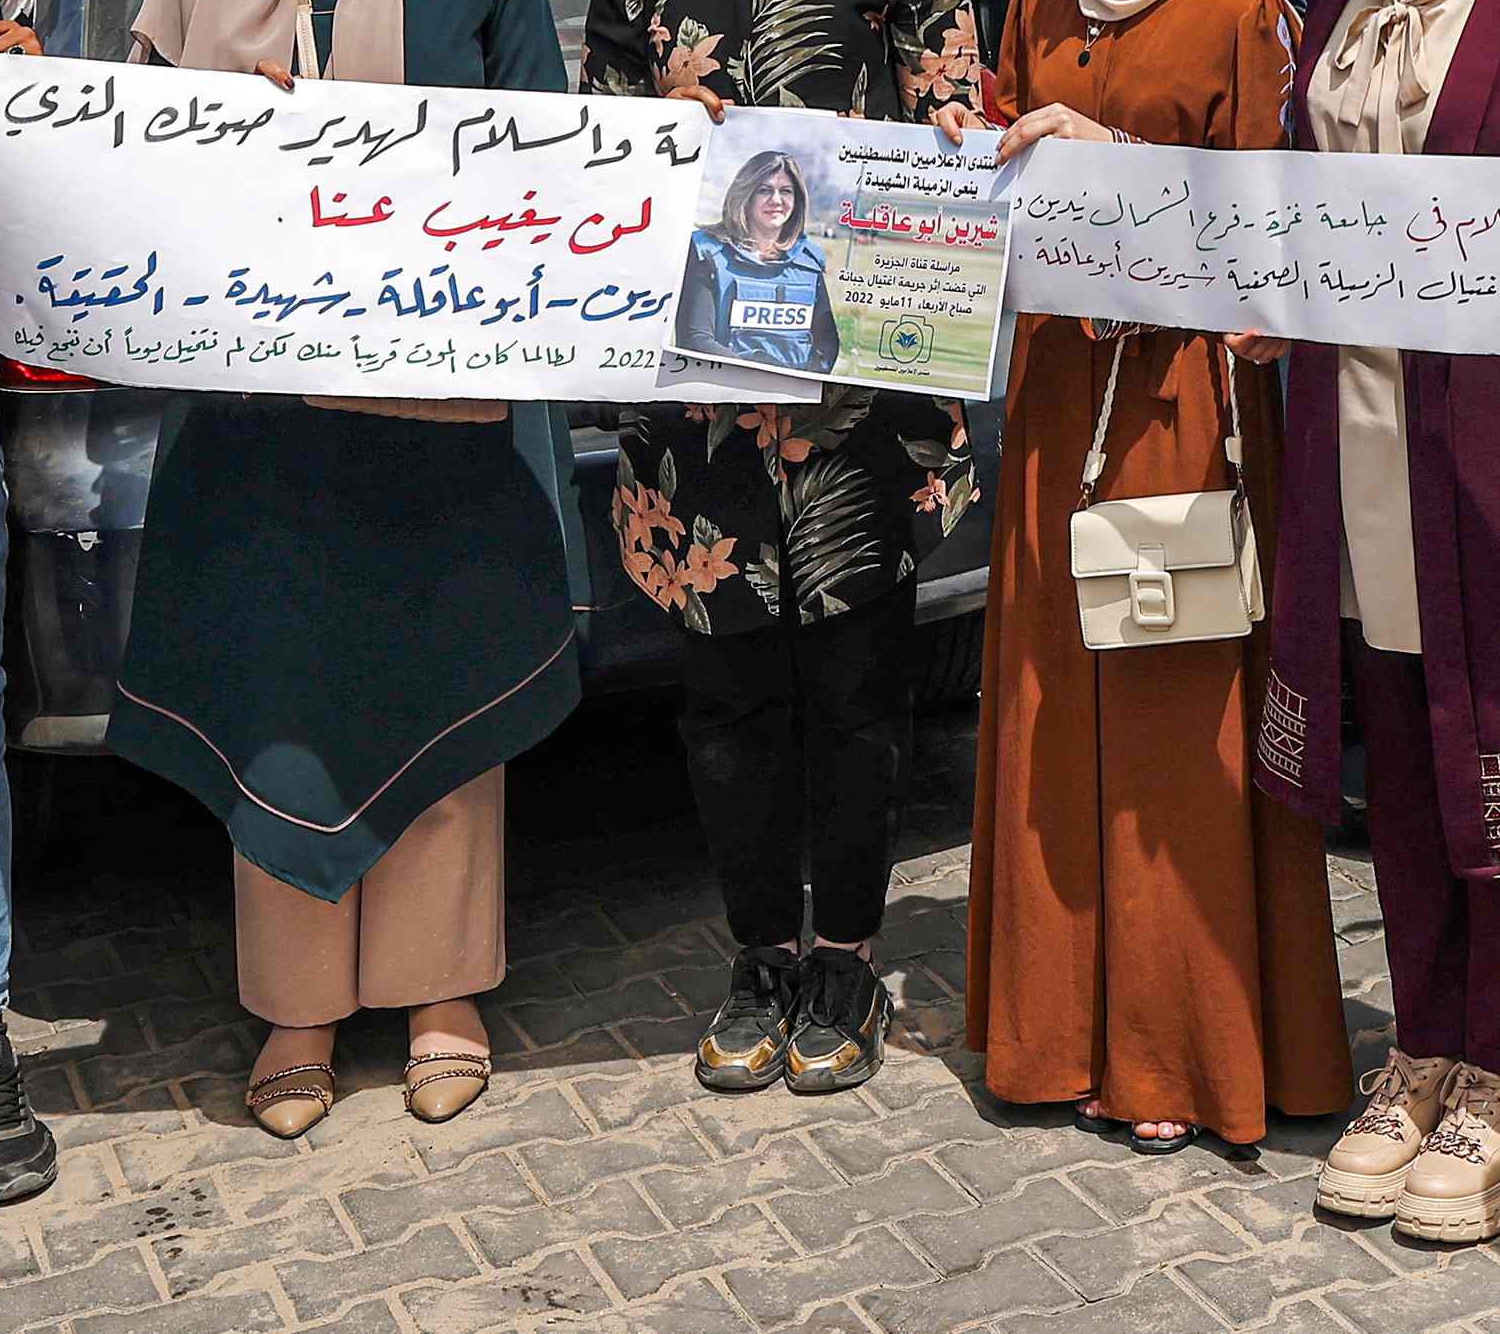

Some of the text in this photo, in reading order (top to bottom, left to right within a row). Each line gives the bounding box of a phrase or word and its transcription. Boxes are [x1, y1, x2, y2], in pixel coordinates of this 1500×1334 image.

[451, 104, 633, 177] والسلام
[838, 144, 910, 166] الفلسطينيين
[910, 152, 967, 173] الإعلاميين
[865, 172, 979, 199] ينعى الزميلة الشهيدة
[1089, 179, 1196, 229] الشمال
[1264, 202, 1303, 238] غزة
[1316, 200, 1388, 237] جامعة
[421, 189, 562, 253] يغيب
[567, 196, 653, 255] لن
[943, 212, 999, 248] شيرين
[1195, 202, 1241, 252] فرع
[1405, 195, 1449, 253] في
[838, 270, 866, 286] جبانة
[874, 253, 961, 276] مراسلة قناة الجزيرة
[1126, 257, 1217, 291] شيرين
[1226, 257, 1310, 302] الصحفية
[224, 266, 353, 322] شهيدة
[843, 289, 874, 306] 2022
[866, 274, 897, 290] اغتيال
[897, 274, 927, 292] جريمة
[941, 280, 968, 295] قضت
[967, 283, 987, 303] التي
[1317, 261, 1405, 303] الزميلة
[741, 305, 808, 326] PRESS
[948, 300, 974, 317] صباح
[465, 338, 520, 371] كان
